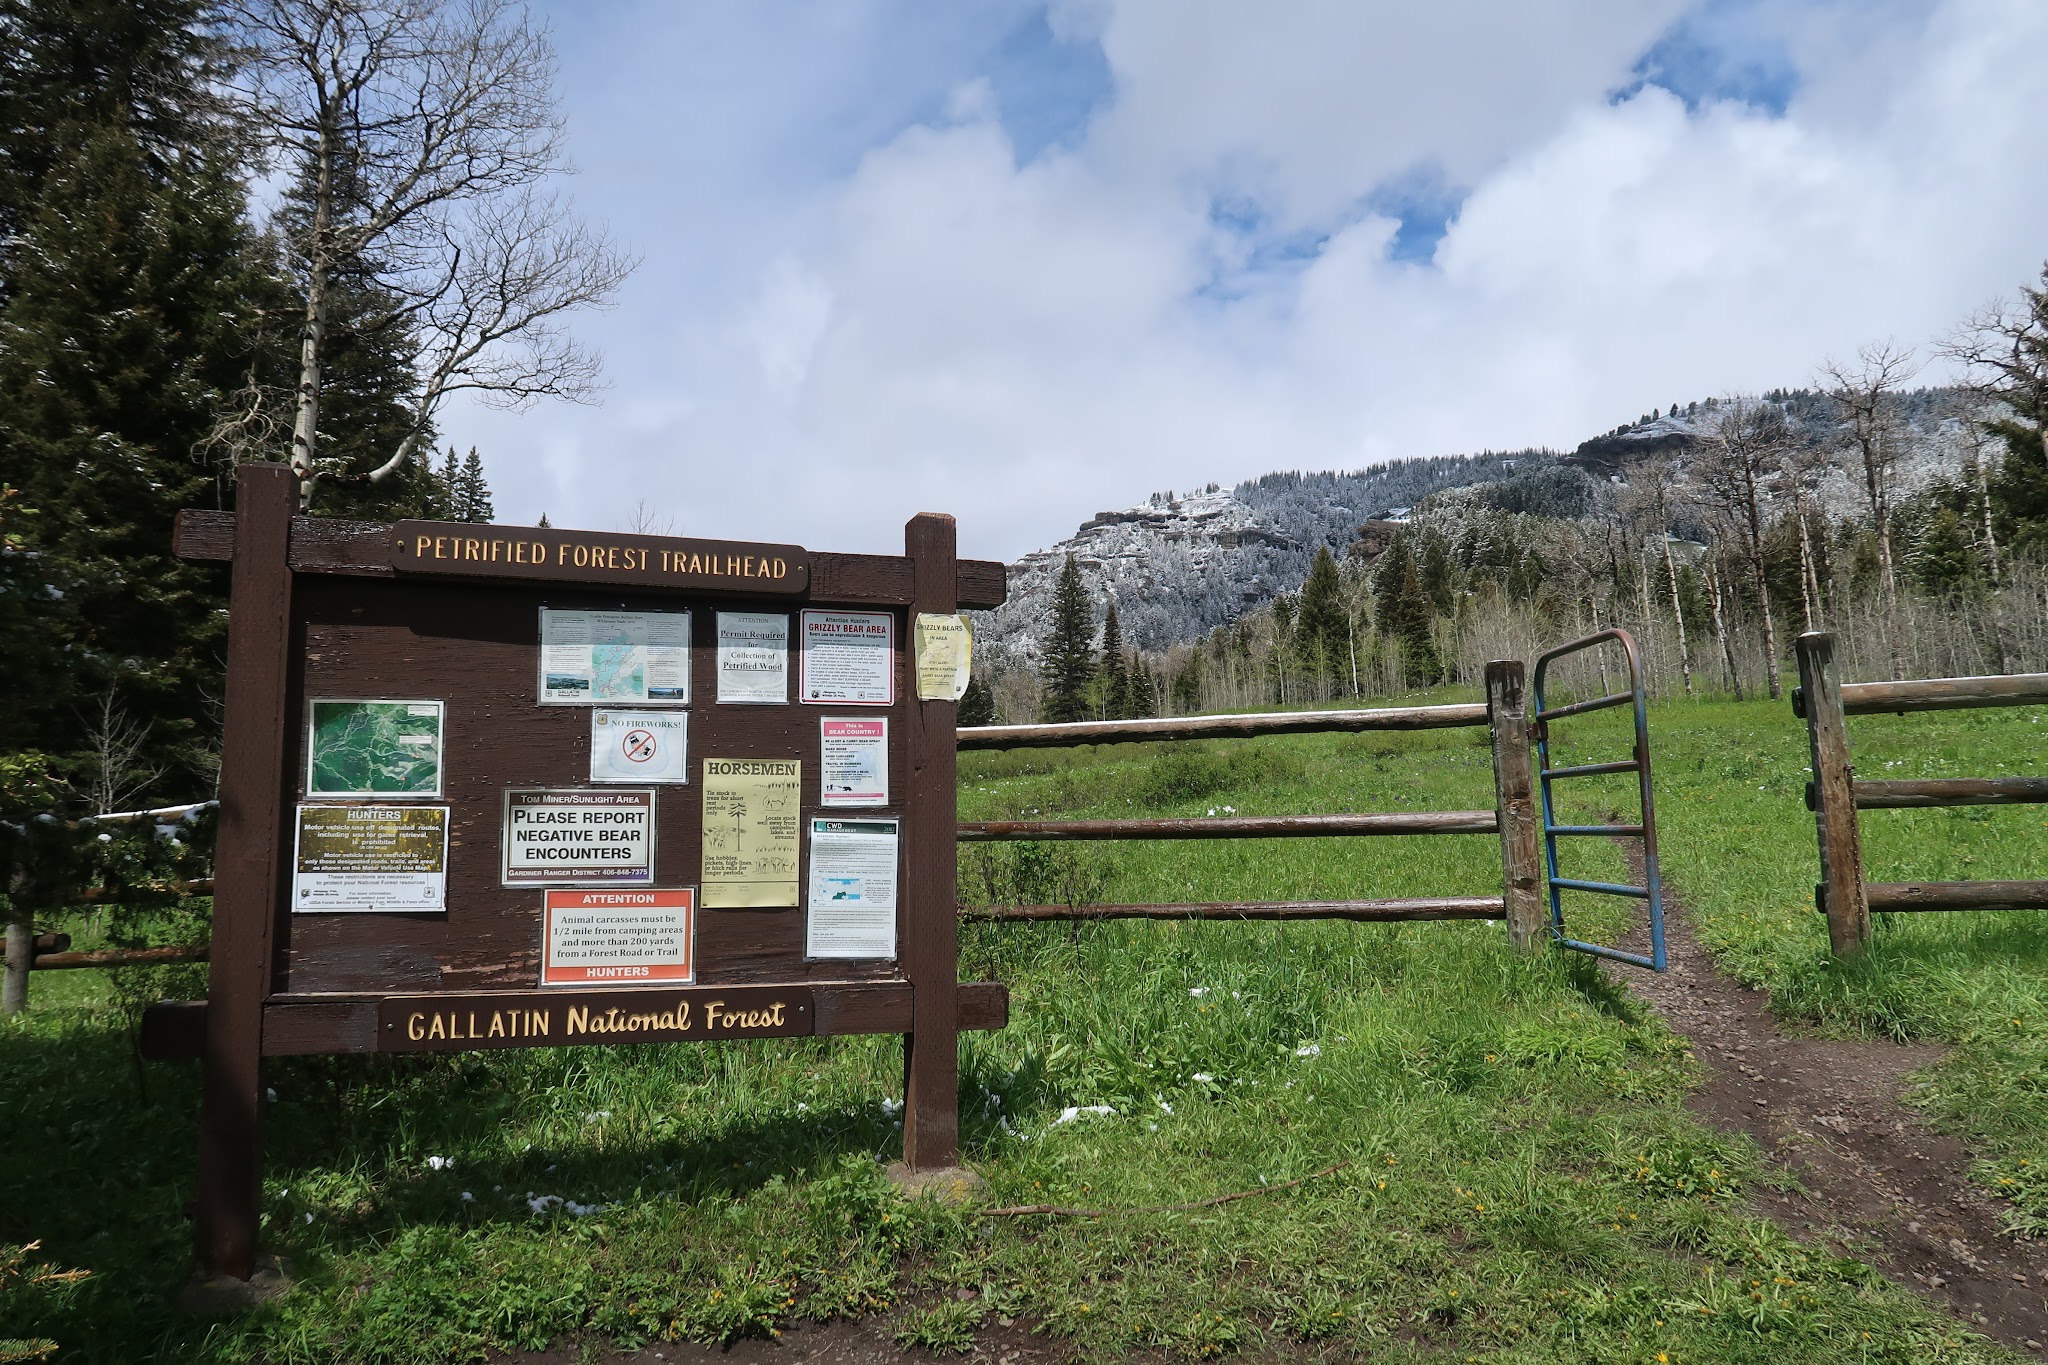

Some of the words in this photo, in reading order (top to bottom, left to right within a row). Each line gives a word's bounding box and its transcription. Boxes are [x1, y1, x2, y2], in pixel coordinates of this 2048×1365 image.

[416, 535, 547, 564] PETRIFIED
[558, 543, 649, 571] FOREST
[660, 550, 787, 579] TRAILHEAD
[808, 623, 841, 632] GRIZZLY
[843, 624, 864, 633] BEAR
[866, 625, 887, 634] AREA
[917, 623, 940, 631] GRIZZLY
[750, 631, 786, 639] Required
[723, 662, 757, 670] Petrified
[626, 720, 681, 728] FIREWORKS!
[708, 762, 796, 776] HORSEMEN
[521, 795, 540, 803] TOM
[543, 794, 614, 804] MINER/SUNLIGHT
[616, 795, 640, 804] AREA
[347, 810, 401, 820] HUNTERS
[514, 809, 577, 824] PLEASE
[582, 812, 645, 824] REPORT
[516, 830, 593, 841] NEGATIVE
[599, 830, 641, 841] BEAR
[526, 847, 631, 859] ENCOUNTERS
[337, 858, 370, 866] designated
[602, 868, 648, 876] 406-848-7375
[582, 894, 655, 904] ATTENTION
[561, 916, 594, 924] Animal
[596, 916, 639, 924] carcasses
[641, 915, 663, 923] must
[665, 915, 676, 923] be
[553, 927, 570, 936] 1/2
[572, 927, 592, 935] mile
[594, 926, 617, 935] from
[618, 926, 657, 936] camping
[659, 926, 683, 934] areas
[561, 938, 579, 946] and
[607, 937, 628, 946] than
[630, 937, 648, 945] 200
[649, 937, 674, 946] yards
[557, 950, 579, 958] from
[589, 949, 618, 957] Forest
[619, 948, 643, 956] Road
[656, 948, 678, 956] Trail
[586, 966, 650, 977] HUNTERS
[407, 1008, 550, 1041] GALLATIN
[566, 1000, 692, 1036] National
[704, 1000, 786, 1030] Forest
